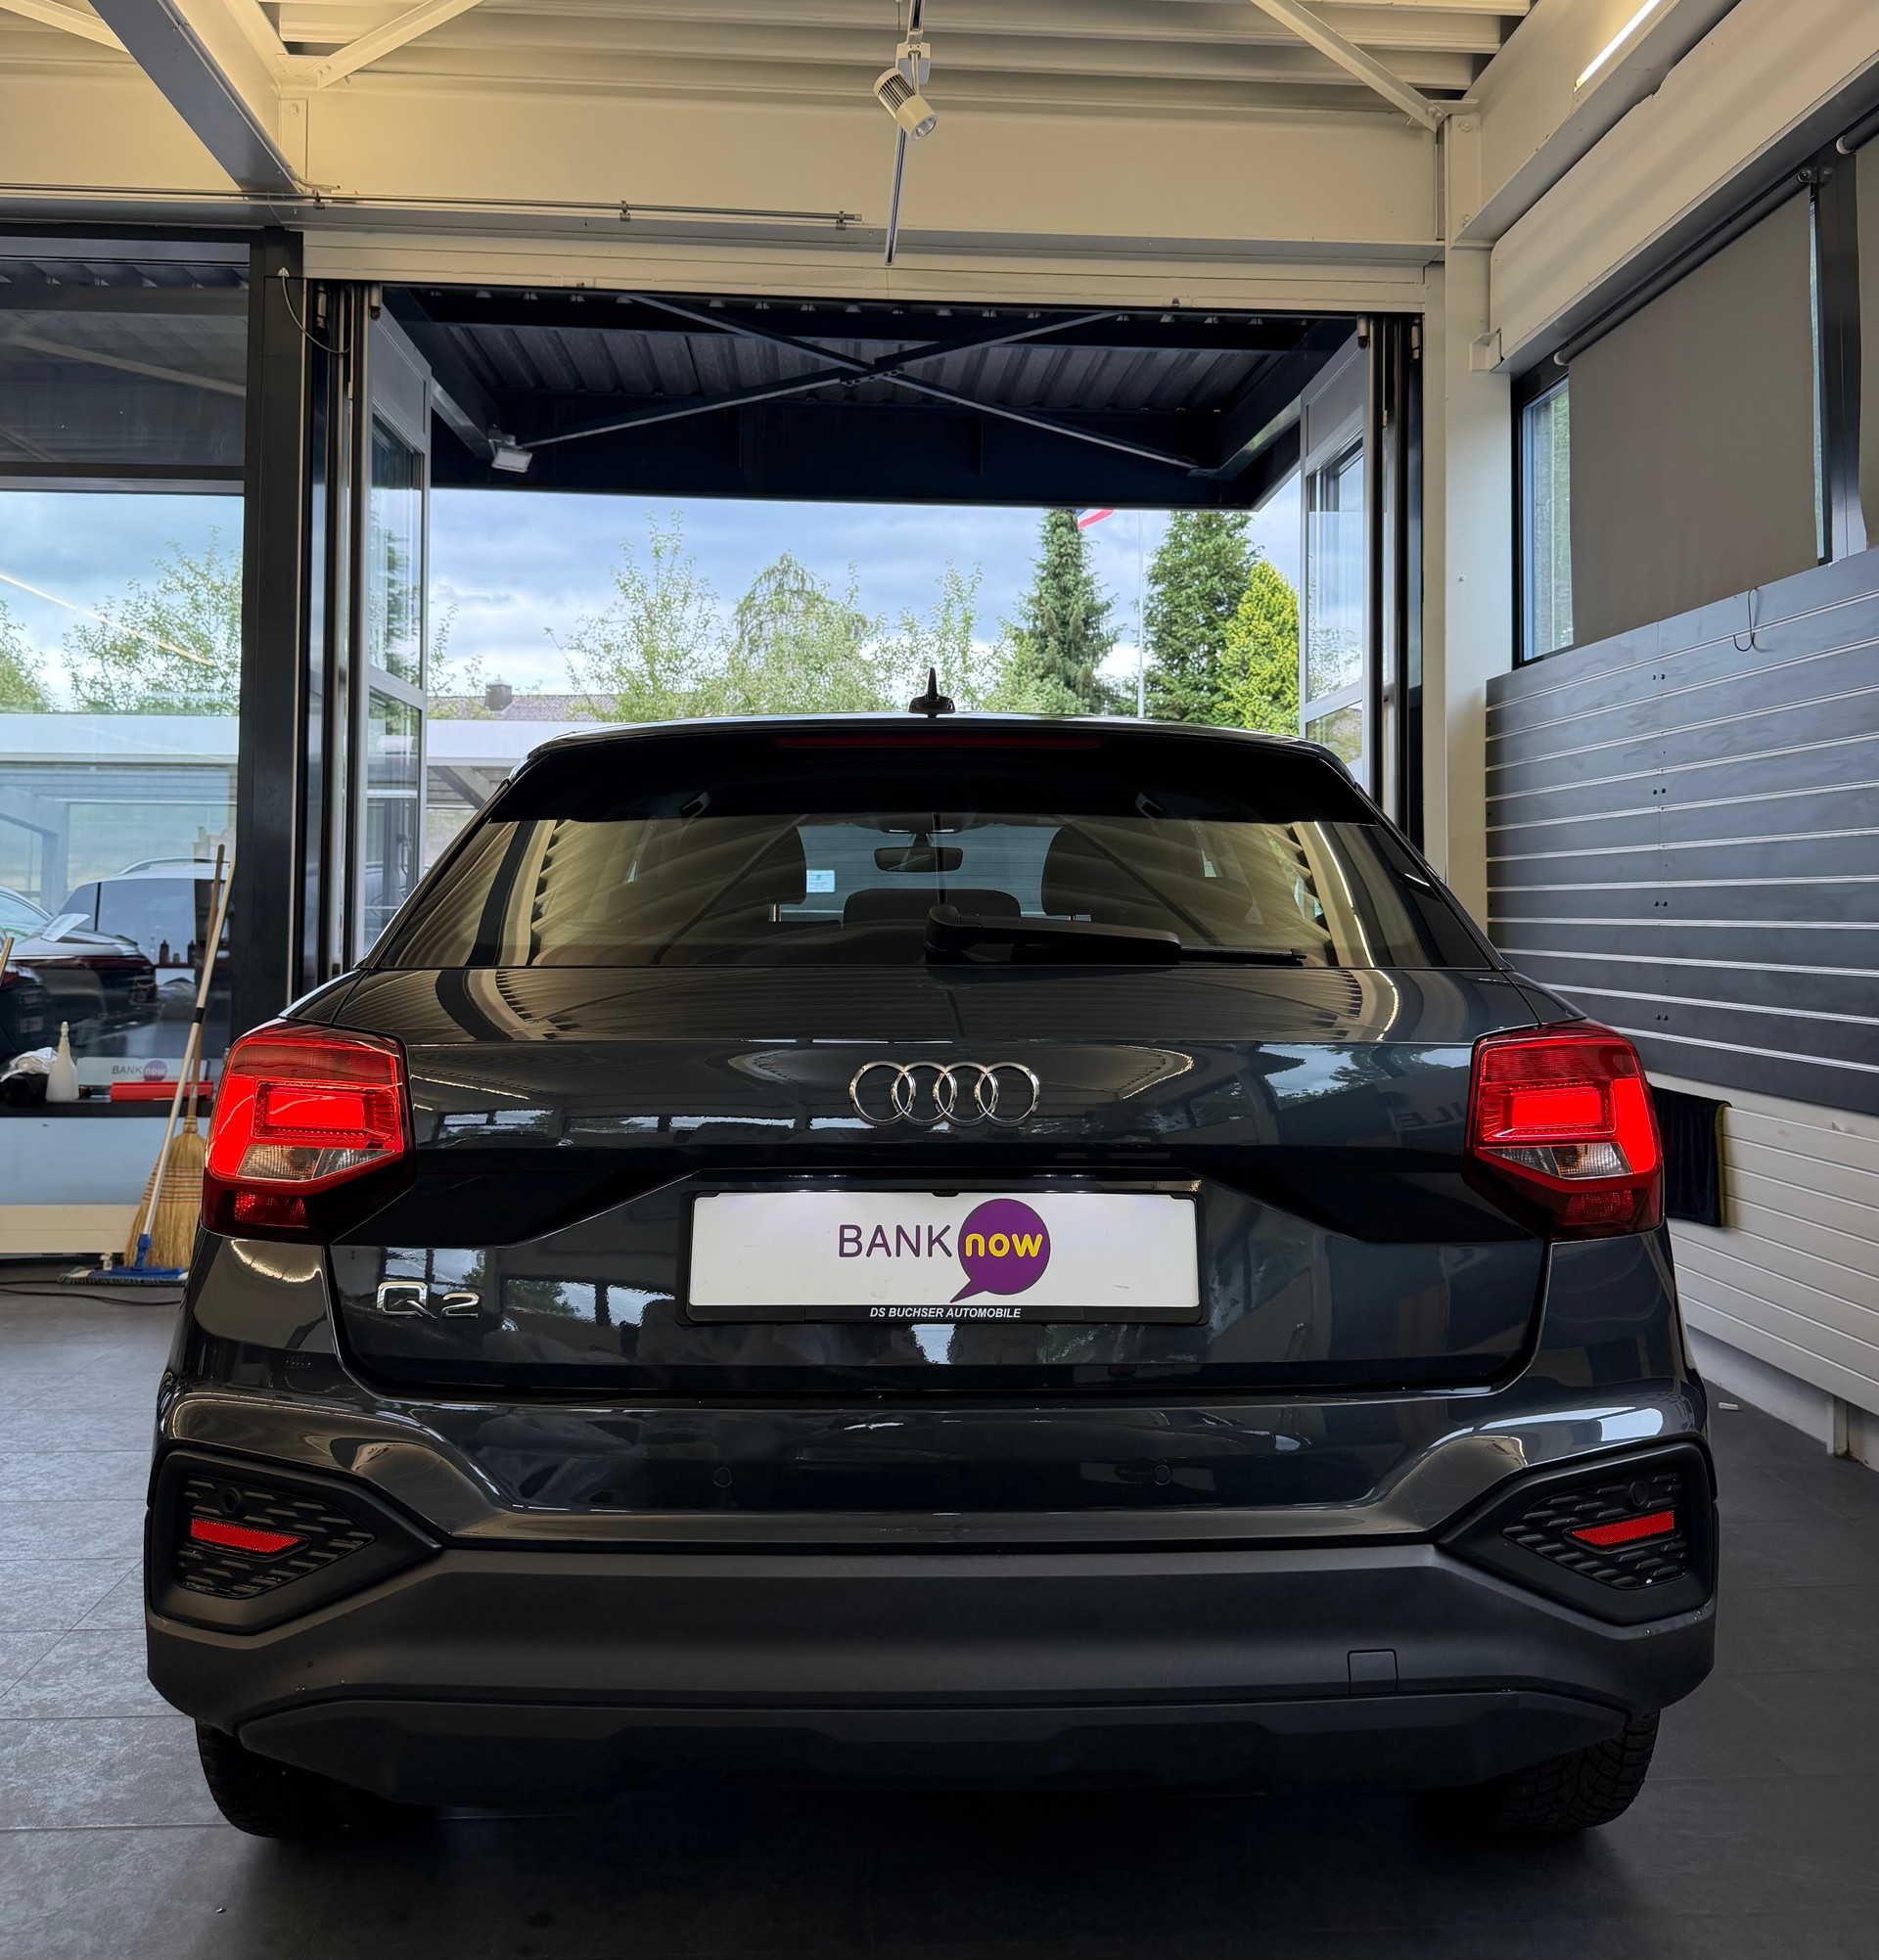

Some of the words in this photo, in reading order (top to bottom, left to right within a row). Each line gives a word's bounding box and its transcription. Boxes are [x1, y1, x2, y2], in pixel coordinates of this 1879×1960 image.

[112, 1065, 143, 1075] BANK
[839, 1224, 953, 1258] BANK
[965, 1233, 1043, 1258] now
[376, 1280, 481, 1320] Q2
[869, 1306, 887, 1318] DS
[888, 1306, 944, 1318] BUCHSER
[945, 1307, 1022, 1319] AUTOMOBILE
